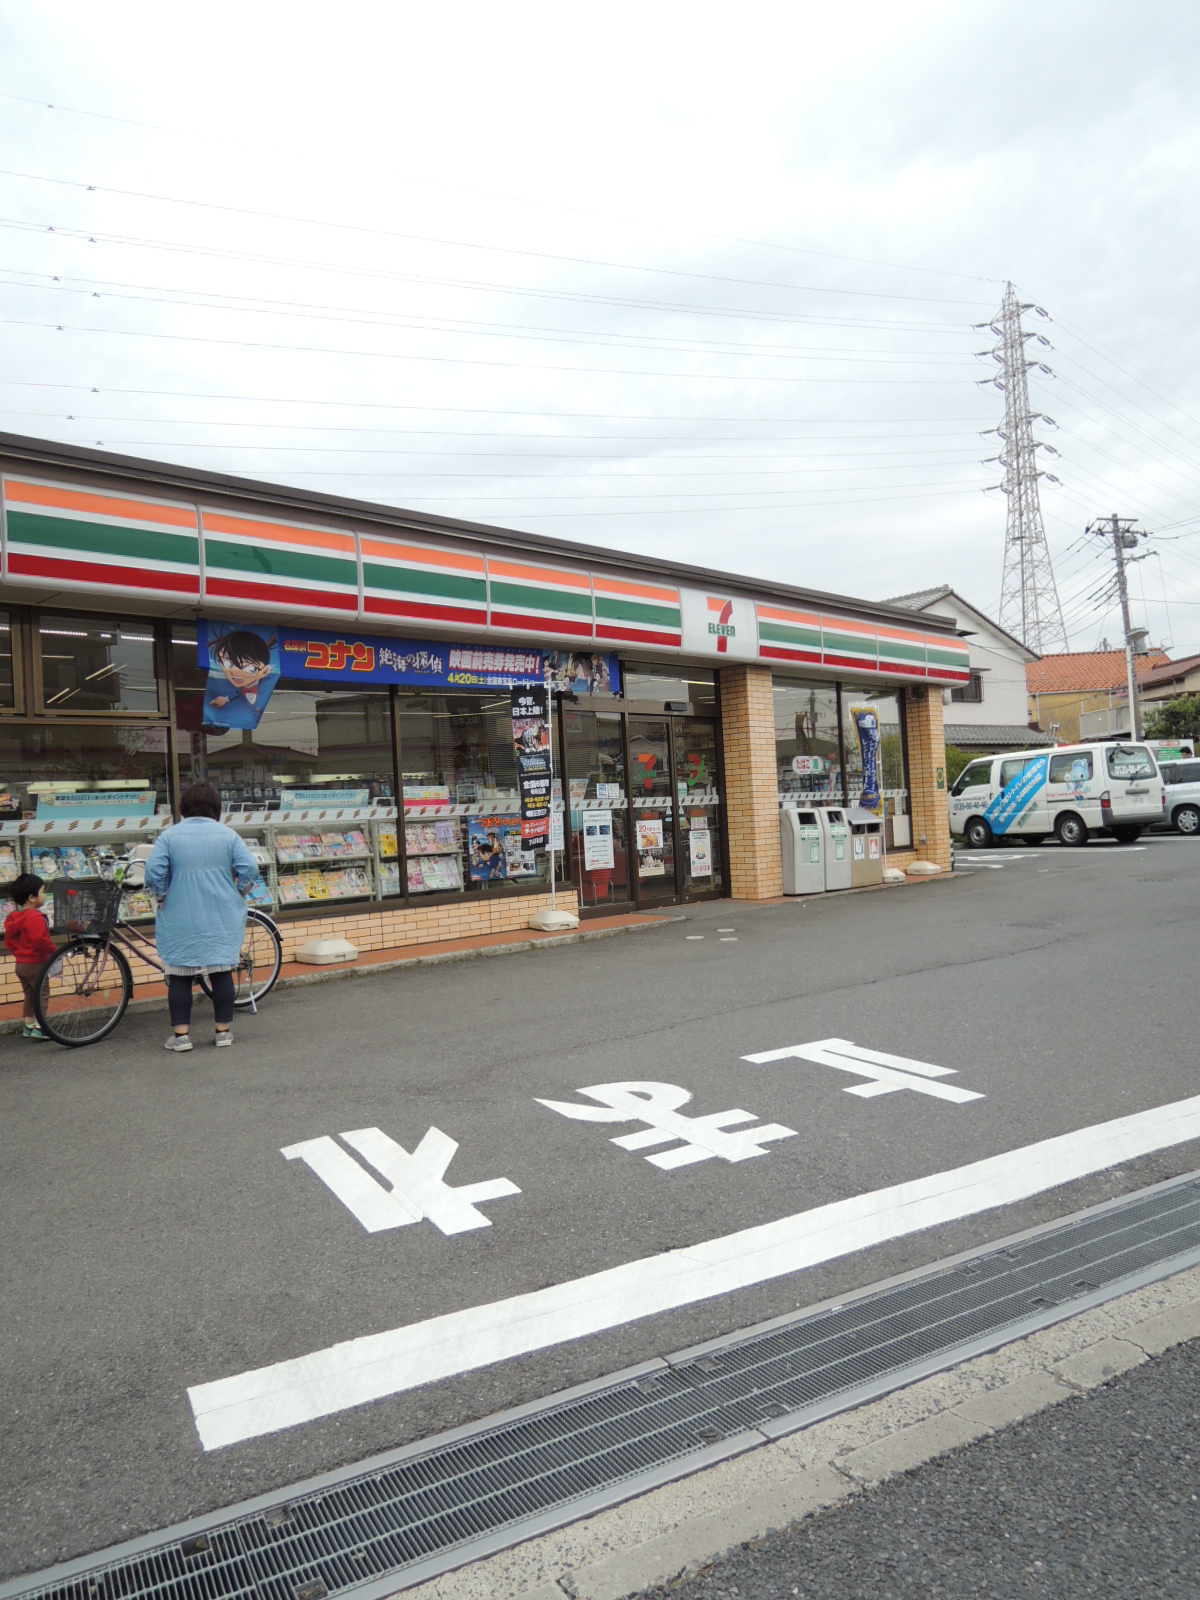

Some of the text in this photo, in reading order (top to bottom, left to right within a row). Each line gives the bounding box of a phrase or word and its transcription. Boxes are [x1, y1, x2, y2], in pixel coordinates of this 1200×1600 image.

[707, 597, 733, 652] 7
[305, 640, 375, 672] コナン
[379, 647, 444, 676] 絶海の探偵
[512, 706, 543, 716] 日本上陸!
[482, 816, 502, 828] コナン
